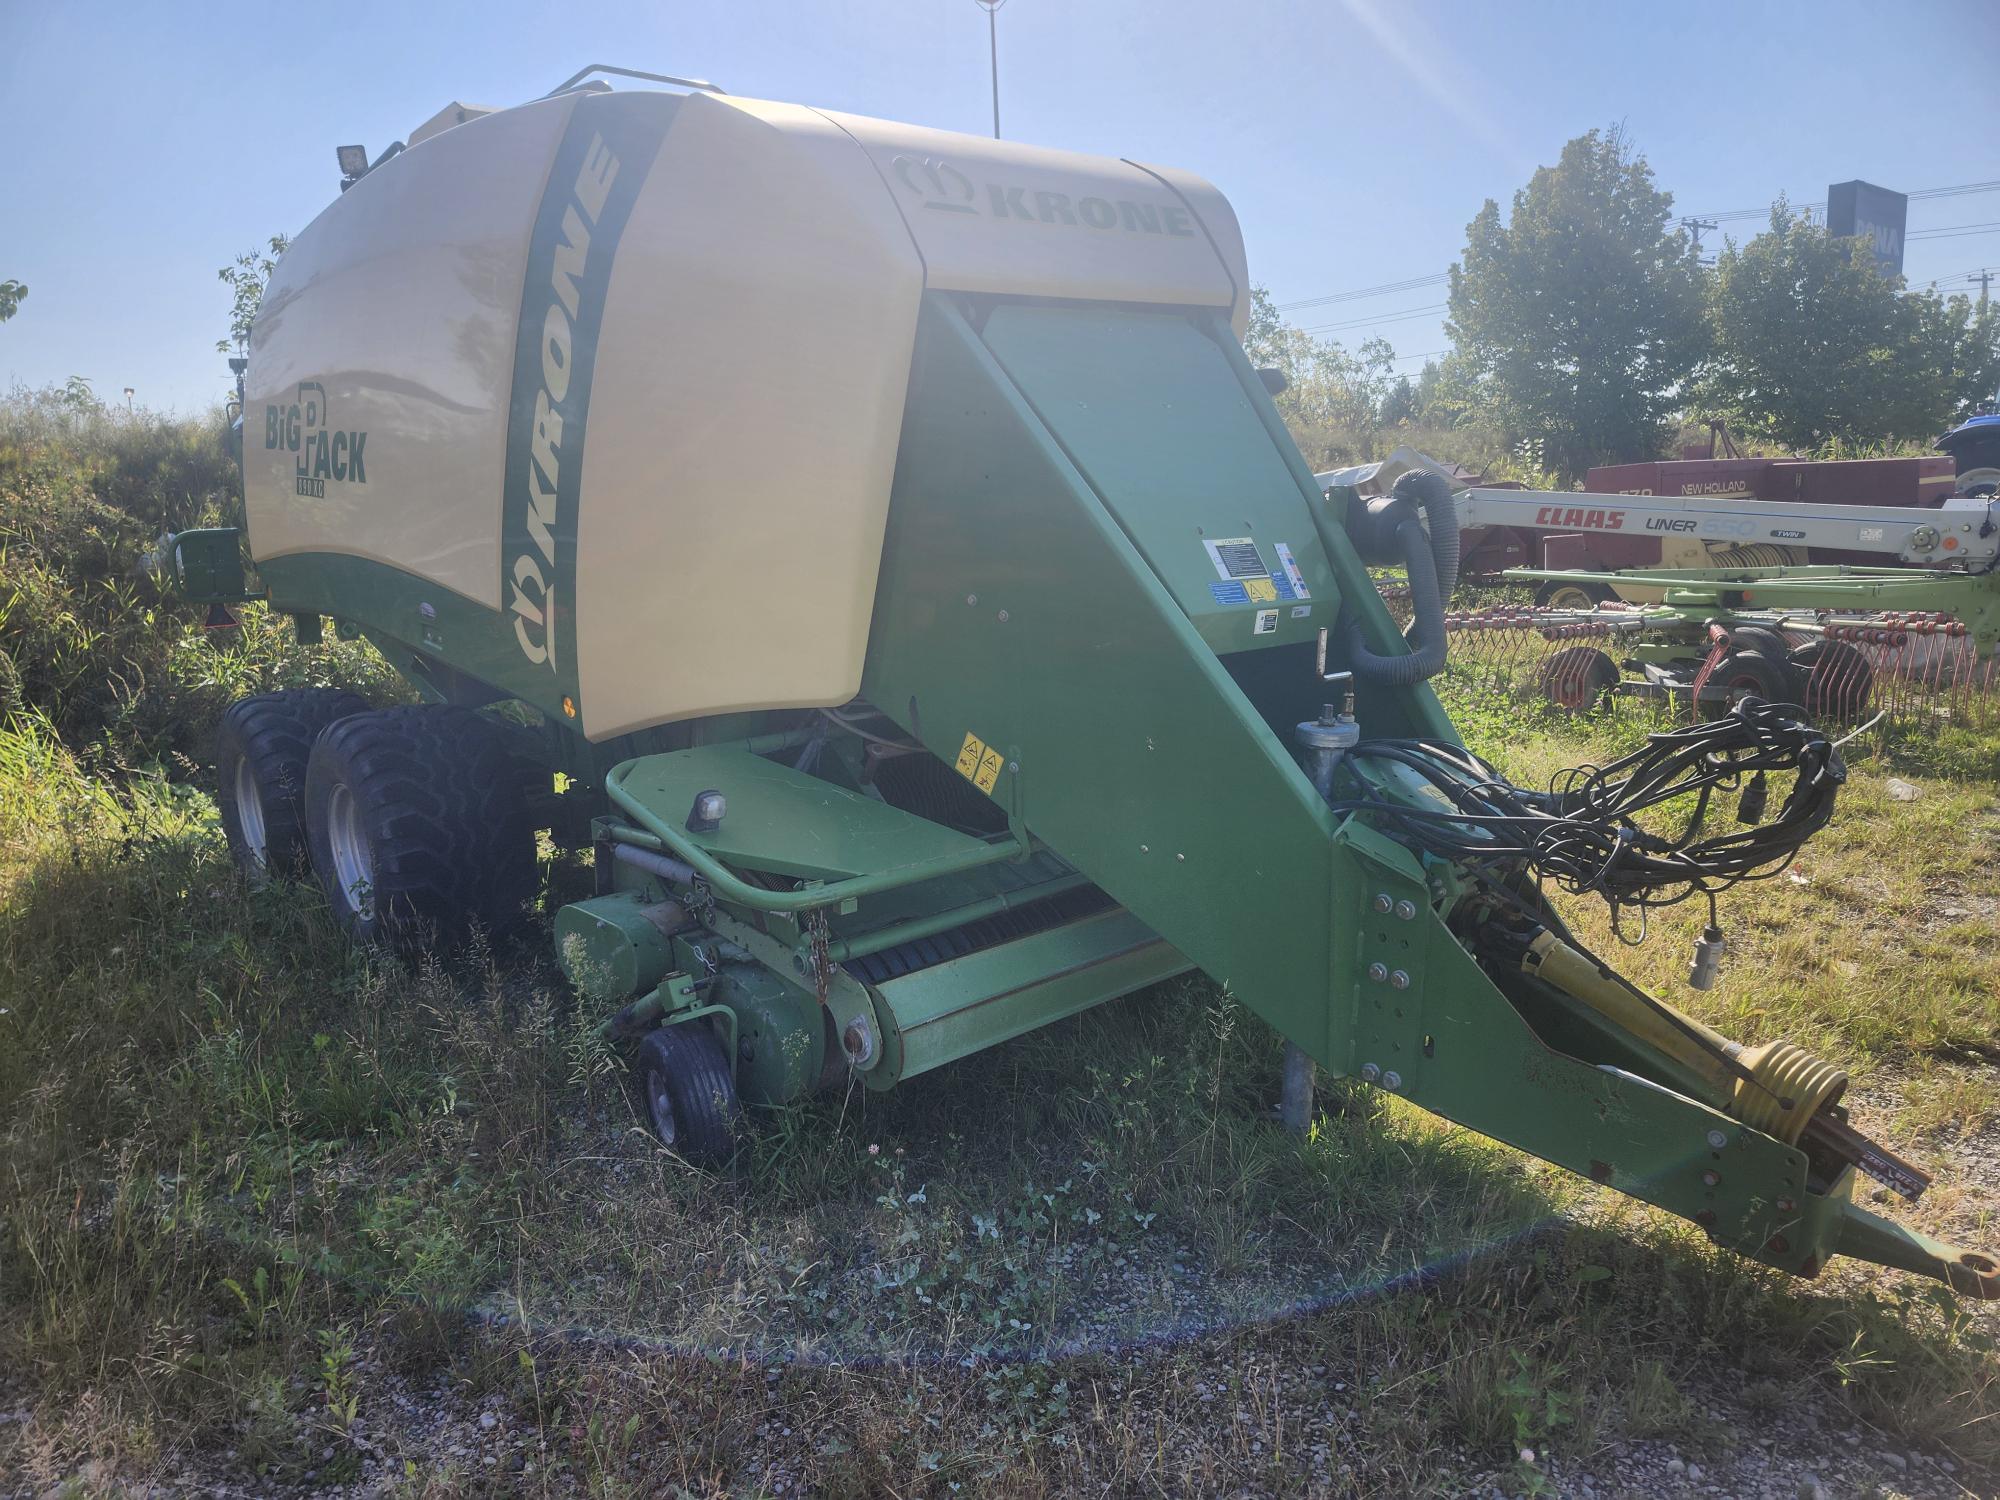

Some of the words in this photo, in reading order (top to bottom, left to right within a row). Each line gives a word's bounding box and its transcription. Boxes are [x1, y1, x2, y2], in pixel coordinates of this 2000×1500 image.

[986, 182, 1196, 237] KRONE
[525, 130, 621, 569] KRONE
[1681, 483, 1703, 496] NEW
[1704, 480, 1746, 494] HOLLAND
[1535, 507, 1626, 530] CLAAS
[1645, 517, 1698, 533] LINER
[1703, 518, 1758, 536] 650
